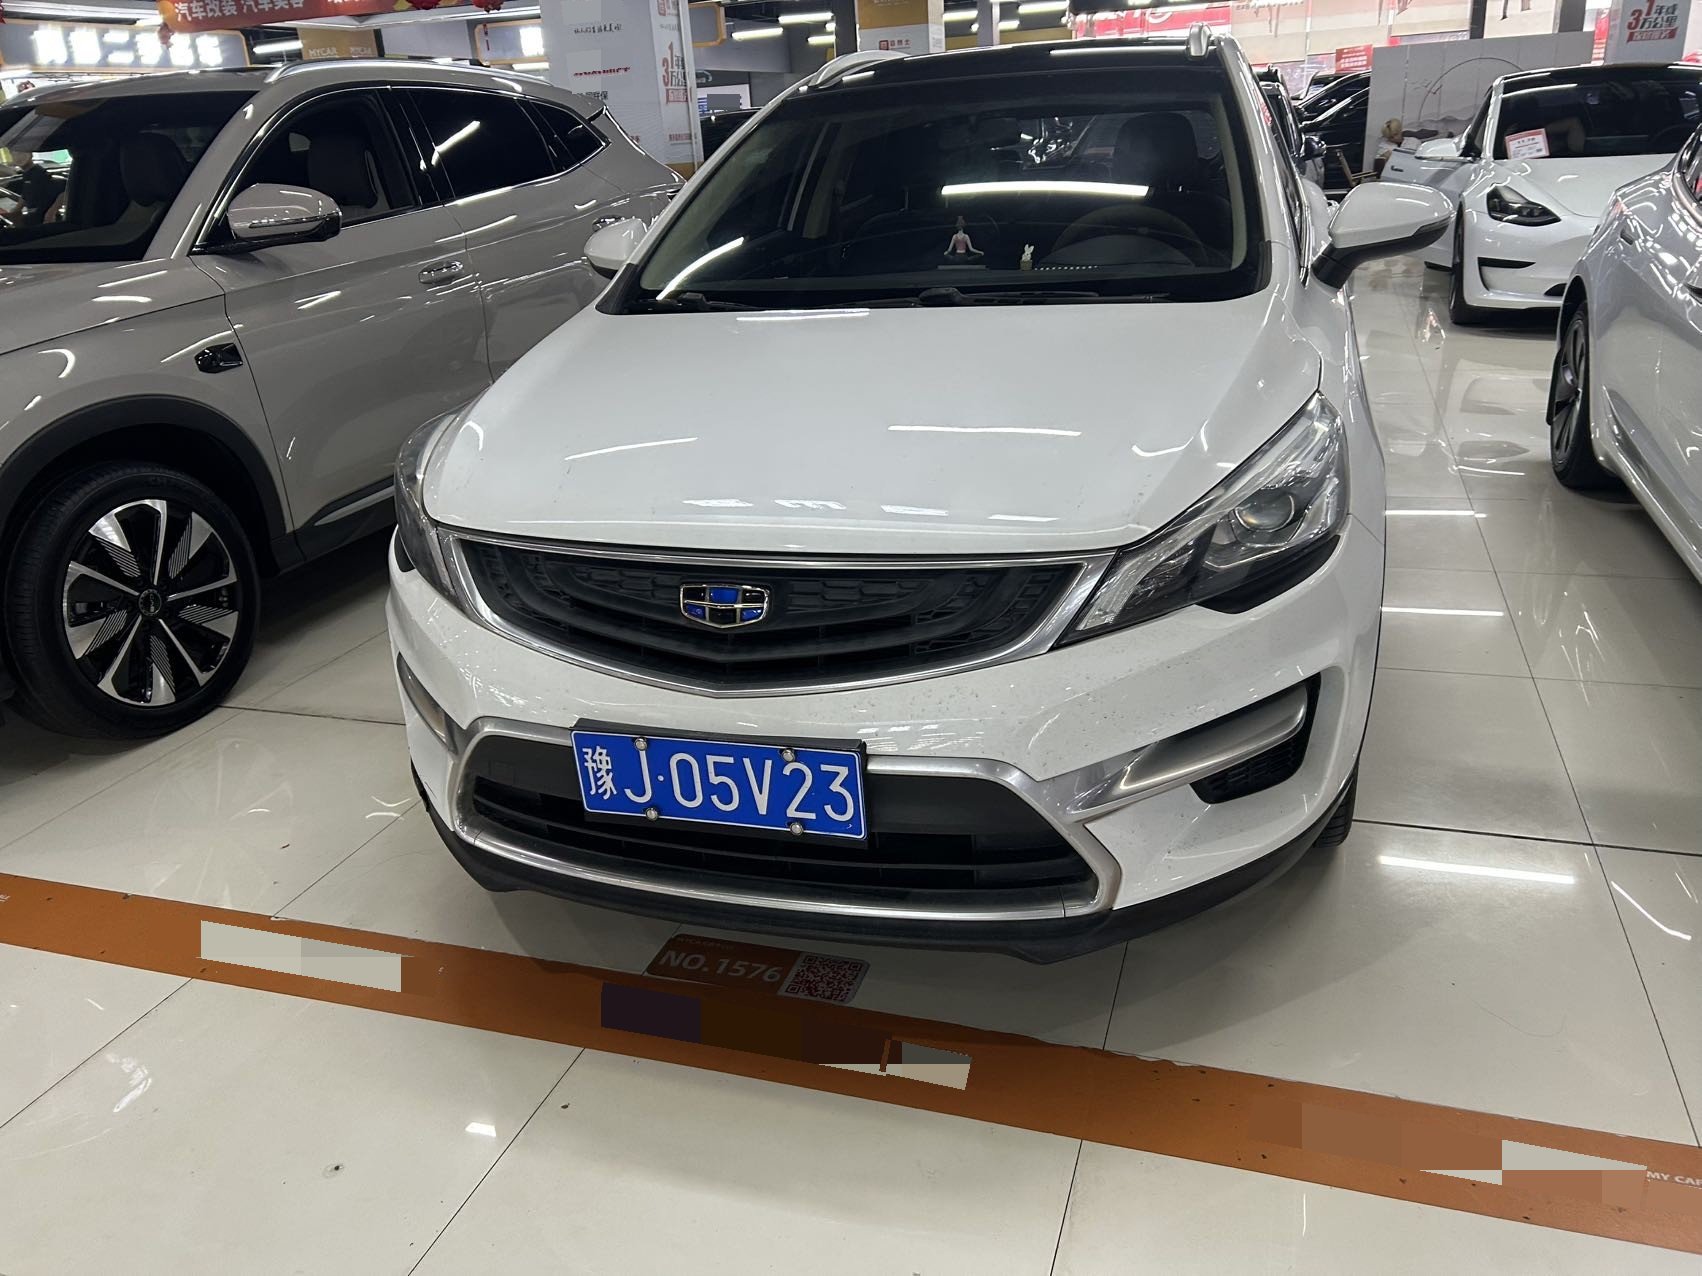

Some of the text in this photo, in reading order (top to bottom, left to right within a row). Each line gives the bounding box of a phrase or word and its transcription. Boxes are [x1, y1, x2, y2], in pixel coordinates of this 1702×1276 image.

[174, 0, 237, 21] 汽车改装
[1626, 9, 1679, 31] 3万公里
[658, 950, 785, 982] NO.1576
